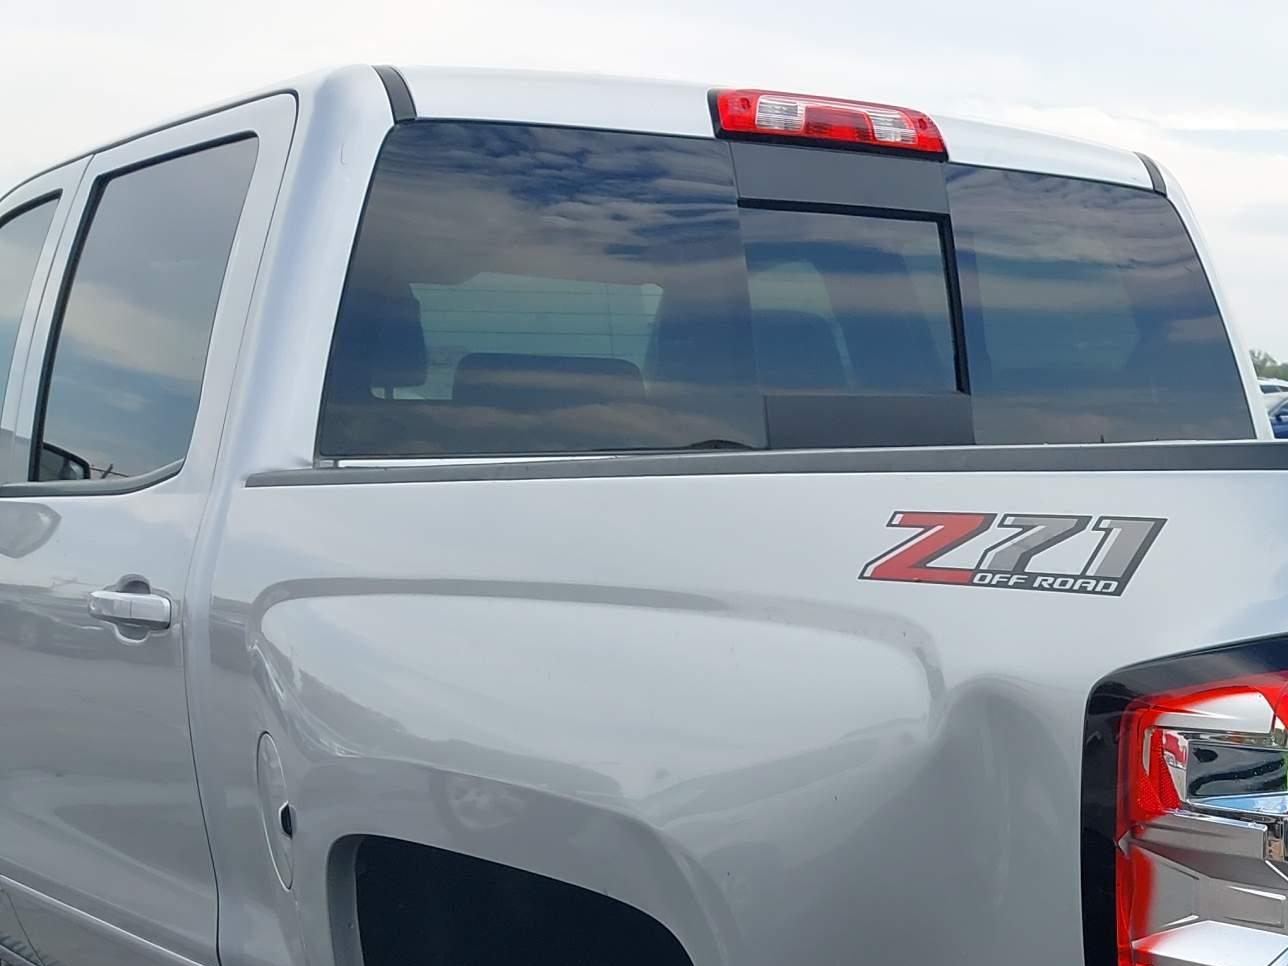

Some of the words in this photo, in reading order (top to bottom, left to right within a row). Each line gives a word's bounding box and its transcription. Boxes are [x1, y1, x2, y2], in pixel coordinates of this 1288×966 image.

[858, 511, 1167, 596] Z71
[971, 572, 1028, 586] OFF
[1032, 576, 1119, 593] ROAD
